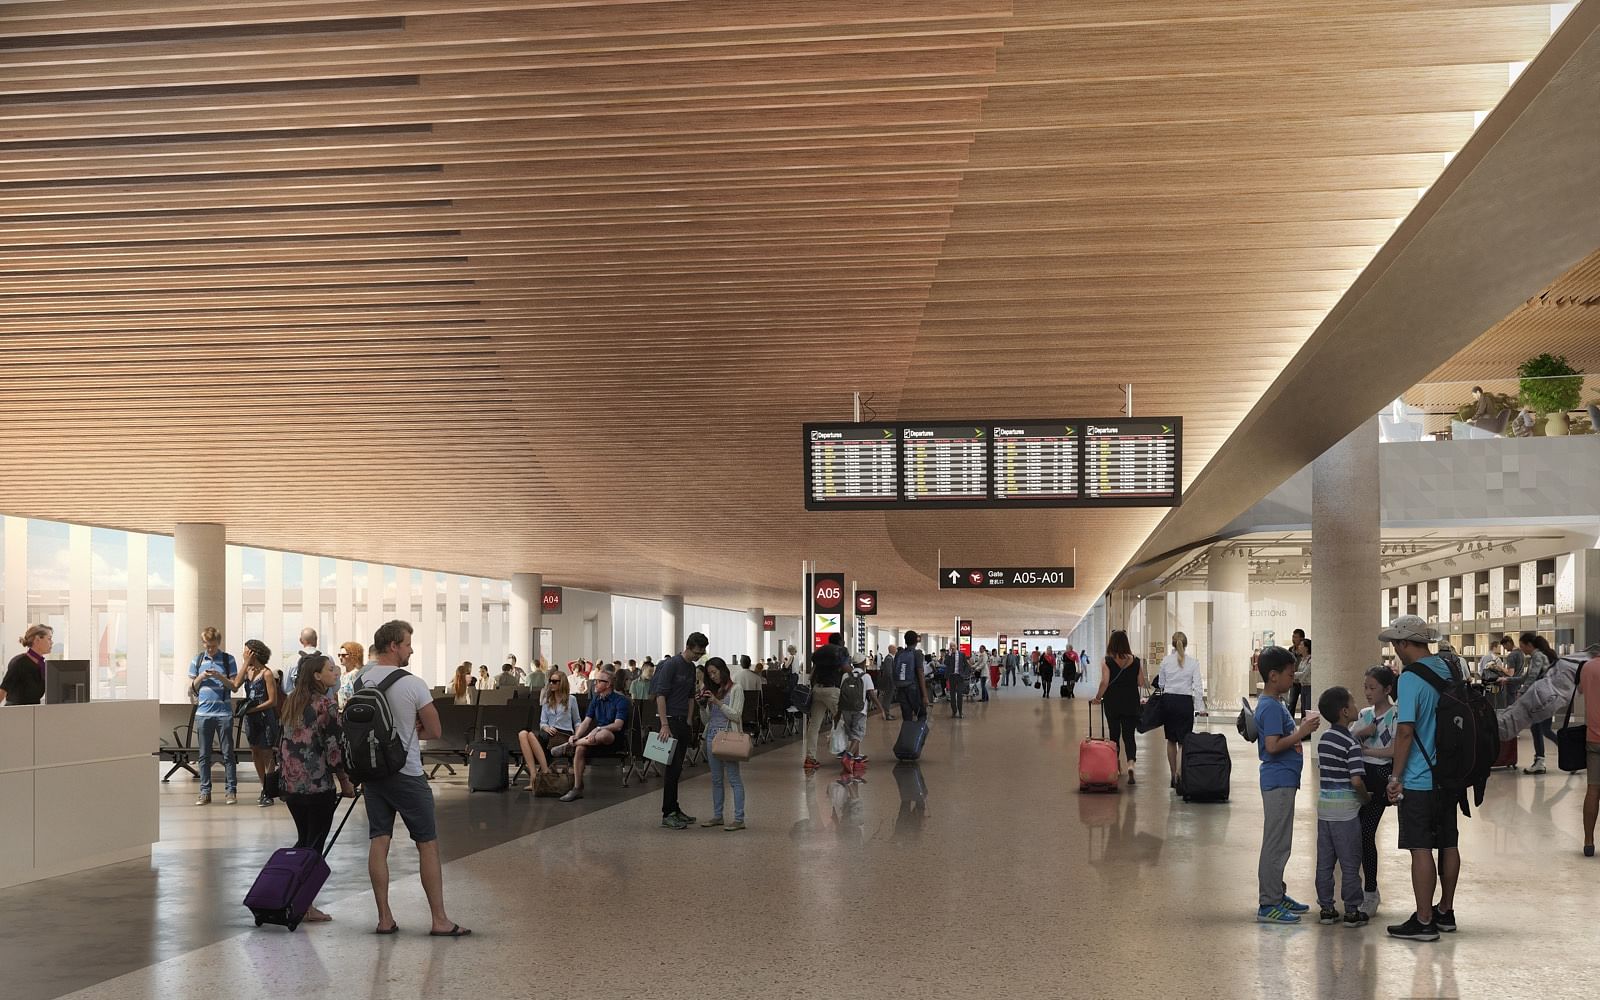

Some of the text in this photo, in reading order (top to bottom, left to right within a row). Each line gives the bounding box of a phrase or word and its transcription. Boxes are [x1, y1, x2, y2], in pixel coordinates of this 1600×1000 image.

[910, 430, 934, 438] Departures
[1000, 428, 1025, 436] Departures
[1094, 427, 1118, 435] Departures
[1013, 572, 1064, 583] A05-A01
[816, 588, 840, 599] A05
[543, 595, 559, 604] A04
[1250, 609, 1287, 617] EDITIONS
